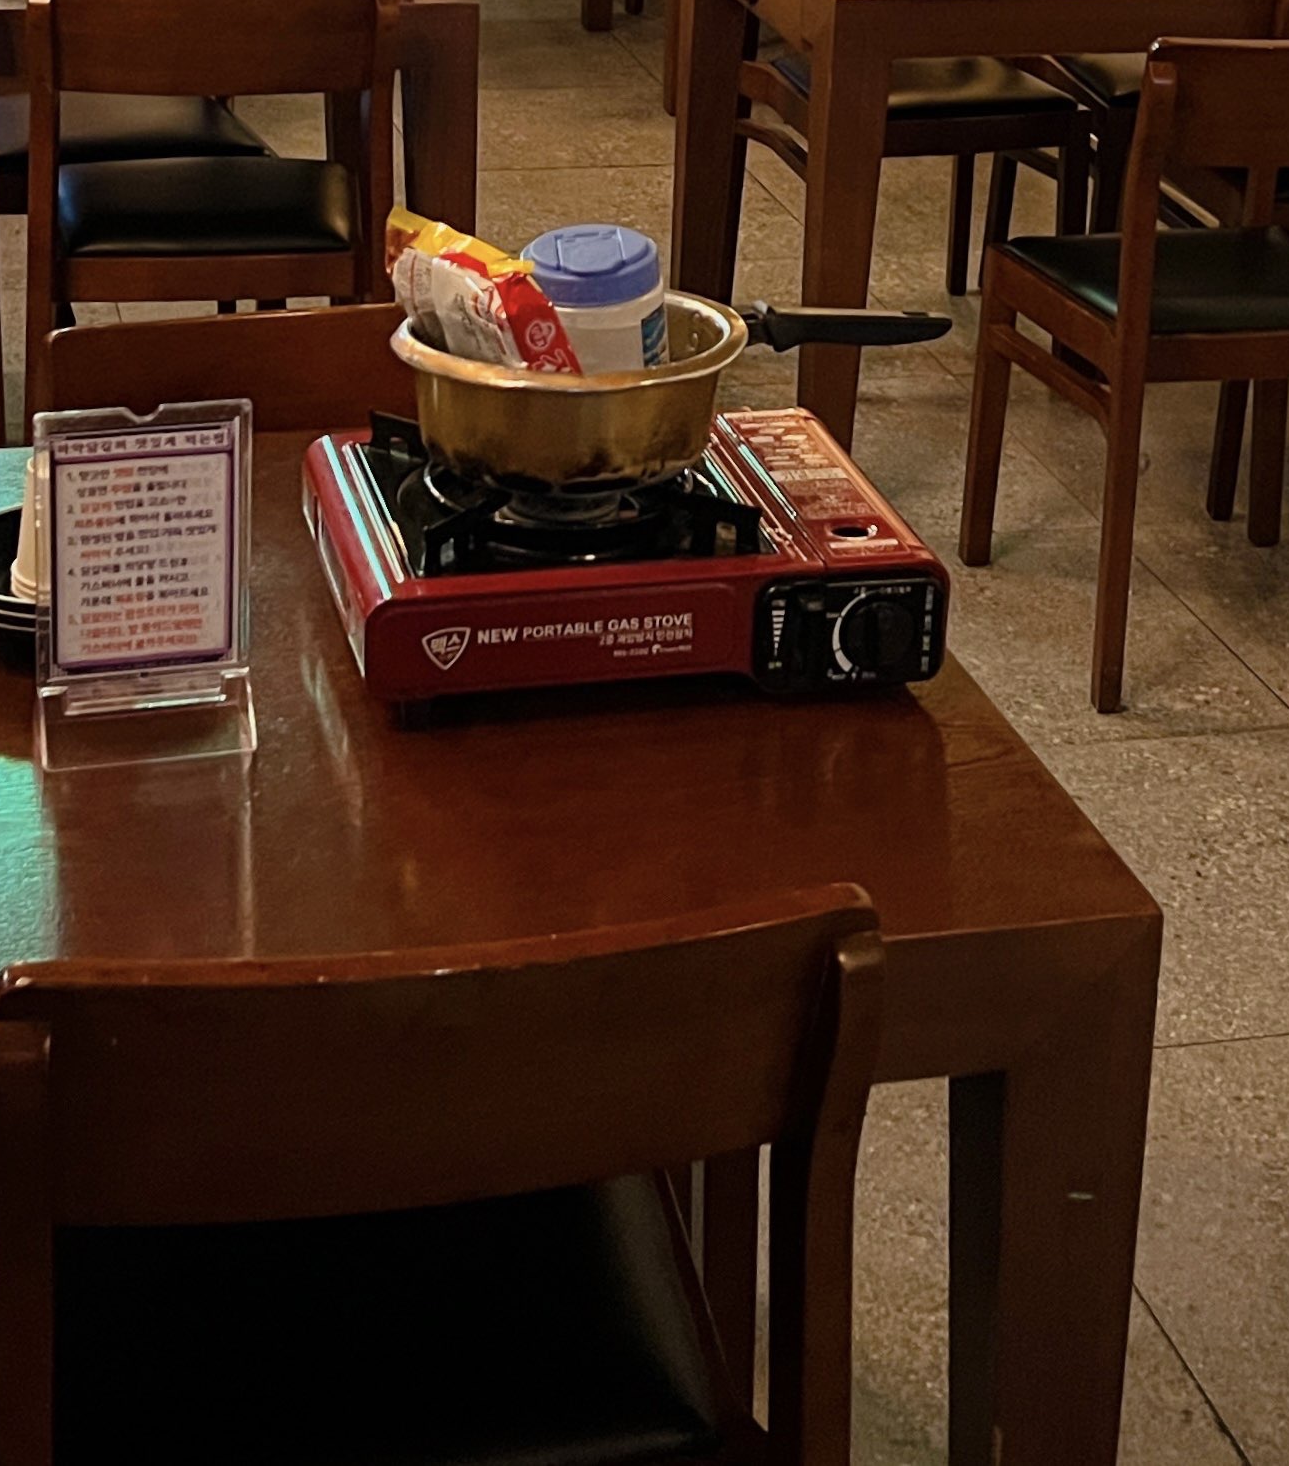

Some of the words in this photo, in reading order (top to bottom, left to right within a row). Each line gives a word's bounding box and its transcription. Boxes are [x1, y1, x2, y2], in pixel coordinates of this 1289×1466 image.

[477, 628, 519, 644] NEW
[523, 620, 603, 640] PORTABLE
[608, 618, 640, 632] GAS
[644, 613, 693, 630] STOVE
